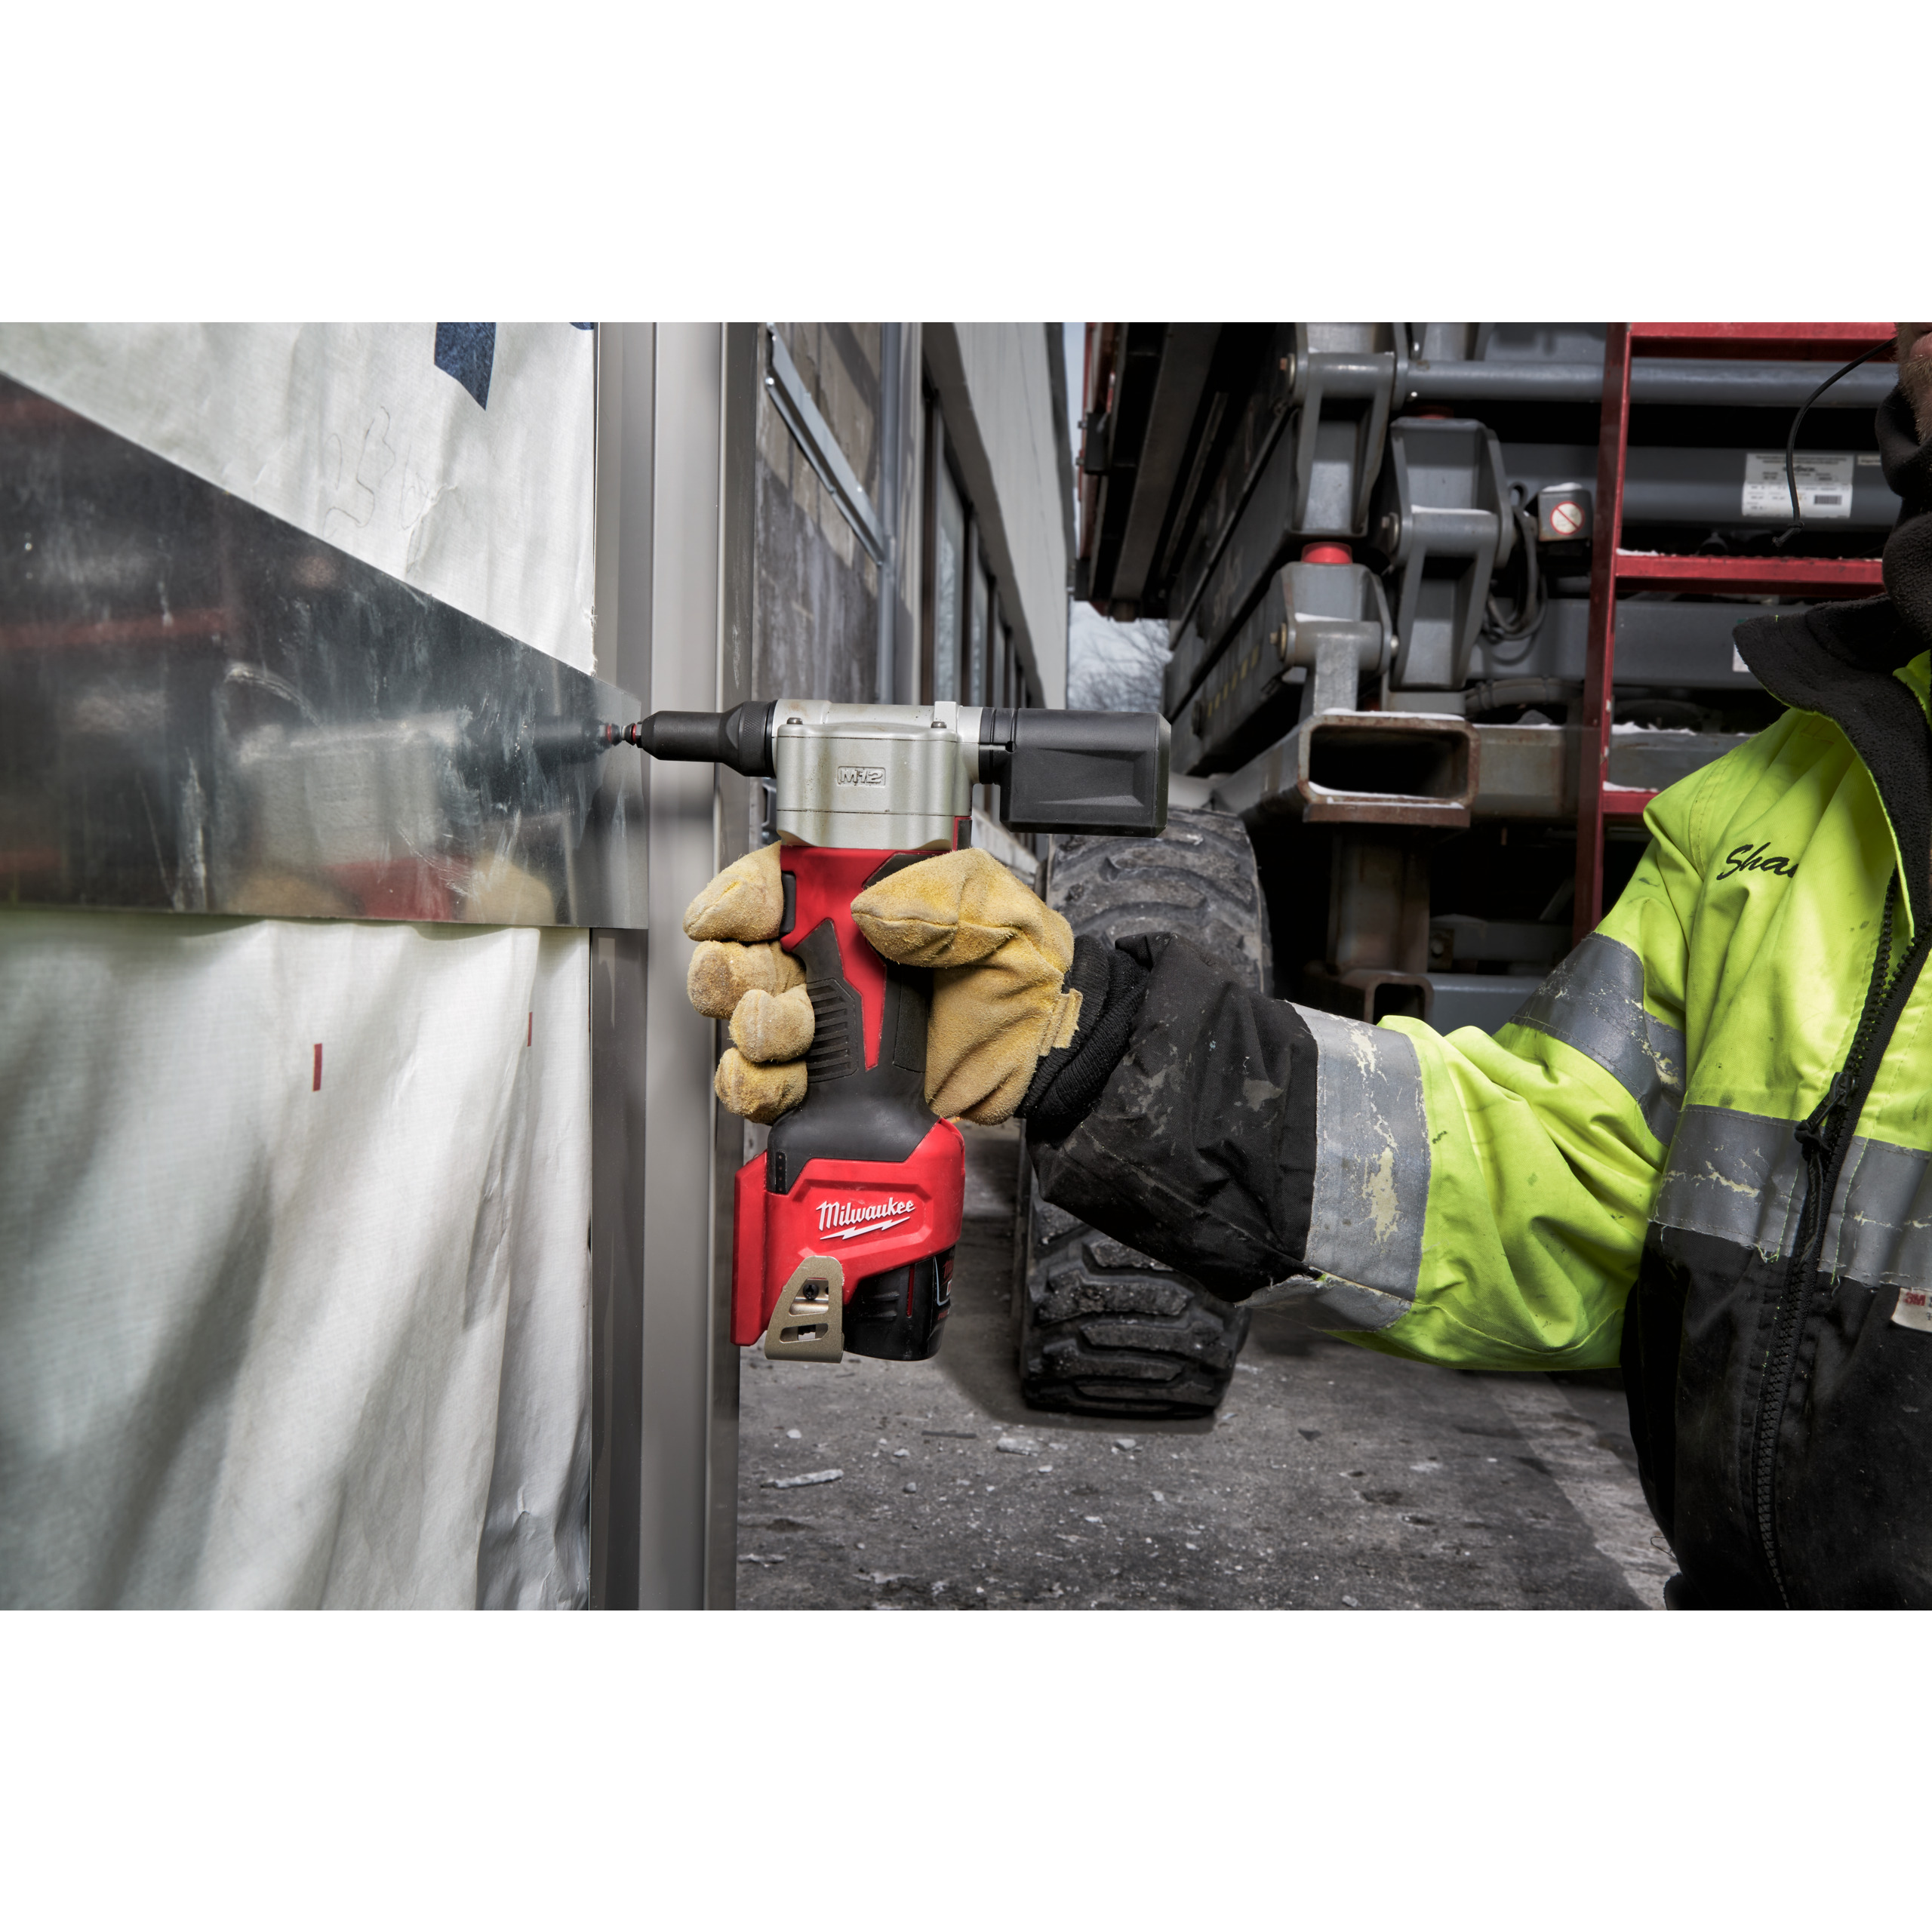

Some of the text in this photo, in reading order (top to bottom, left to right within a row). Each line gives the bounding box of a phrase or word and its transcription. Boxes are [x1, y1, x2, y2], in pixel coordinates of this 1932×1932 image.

[839, 768, 884, 784] M12
[816, 1197, 915, 1232] Milwaukee
[1903, 1291, 1926, 1306] 3M
